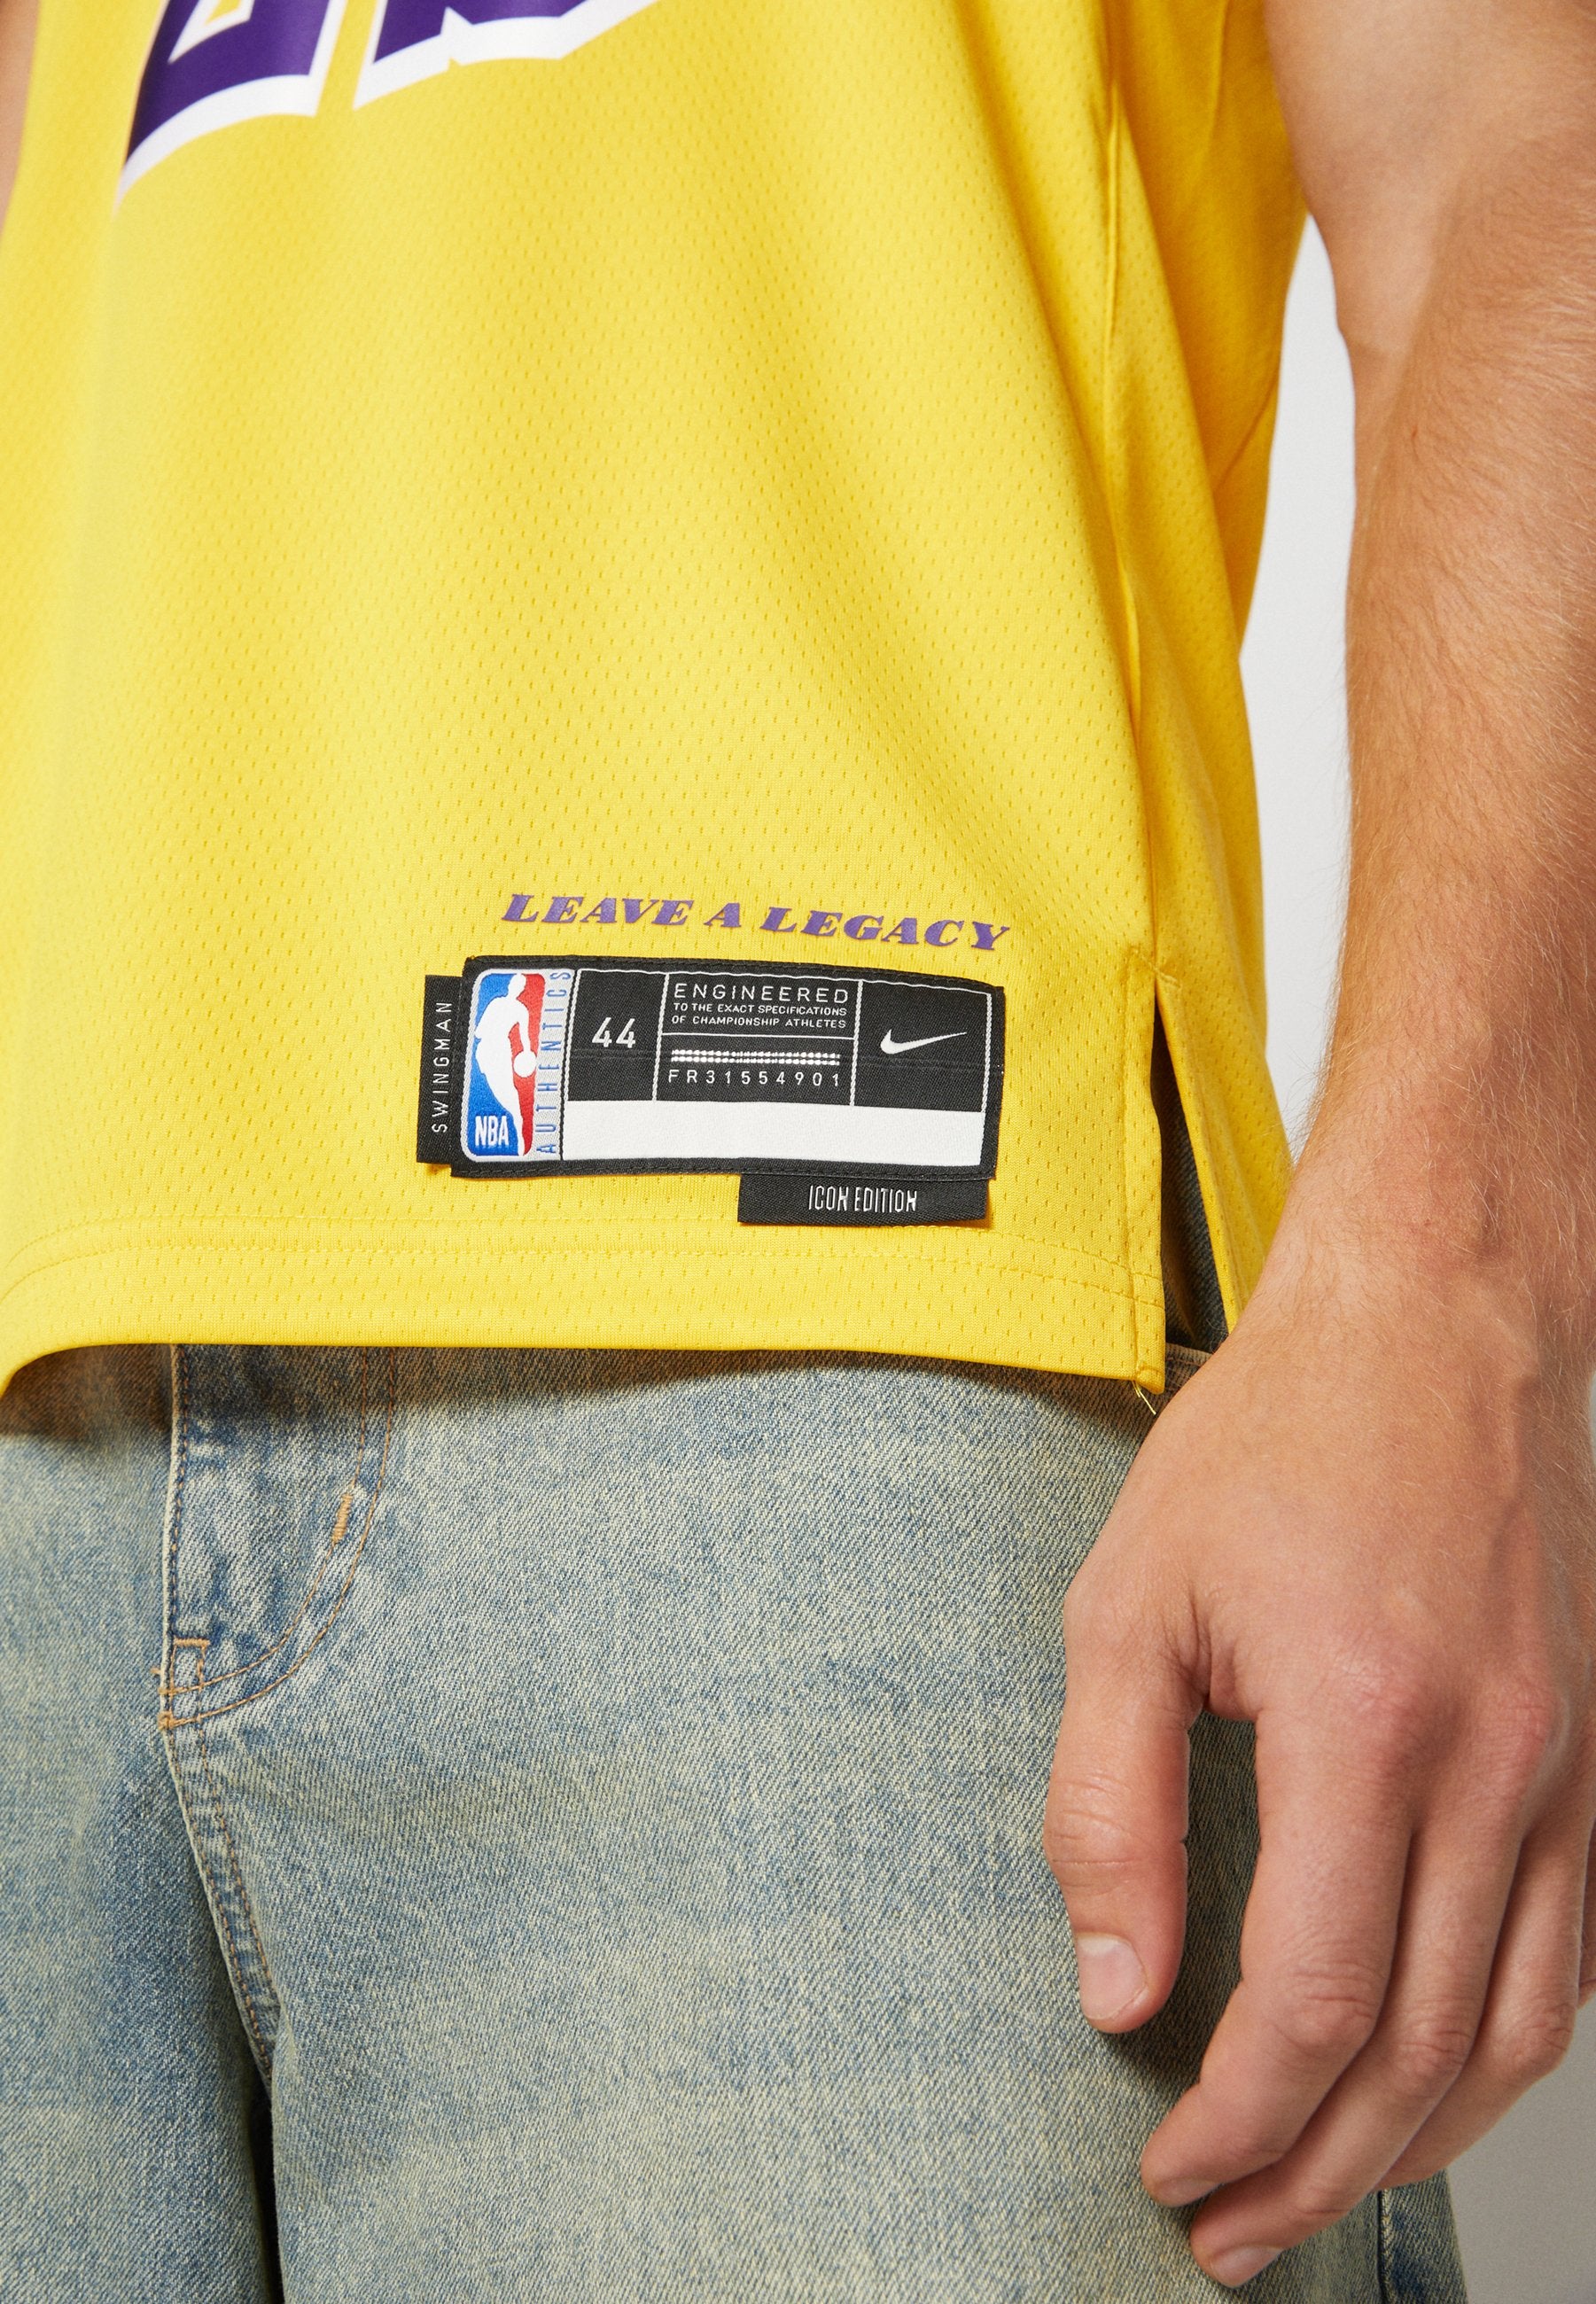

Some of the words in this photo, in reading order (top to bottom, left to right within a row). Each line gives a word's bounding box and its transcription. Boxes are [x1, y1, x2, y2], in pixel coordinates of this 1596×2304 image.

[502, 894, 694, 925] LEAVE
[704, 902, 741, 928] A
[759, 907, 1009, 950] LEGACY
[673, 983, 848, 1003] ENGINEERED
[671, 1015, 687, 1024] OF
[692, 1016, 779, 1026] CHAMPIONSHIP
[784, 1018, 846, 1028] ATHLETES
[673, 1002, 688, 1012] TO
[691, 1003, 712, 1013] THE
[717, 1004, 753, 1014] EXACT
[758, 1006, 847, 1016] SPECIFICATIONS
[591, 1017, 636, 1048] 44
[432, 1002, 453, 1133] SWINGMAN
[534, 971, 572, 1154] AUTHENTICS
[668, 1069, 839, 1086] FR31554901
[474, 1115, 510, 1147] NBA
[808, 1185, 848, 1211] ICON
[853, 1187, 917, 1213] EDITION
